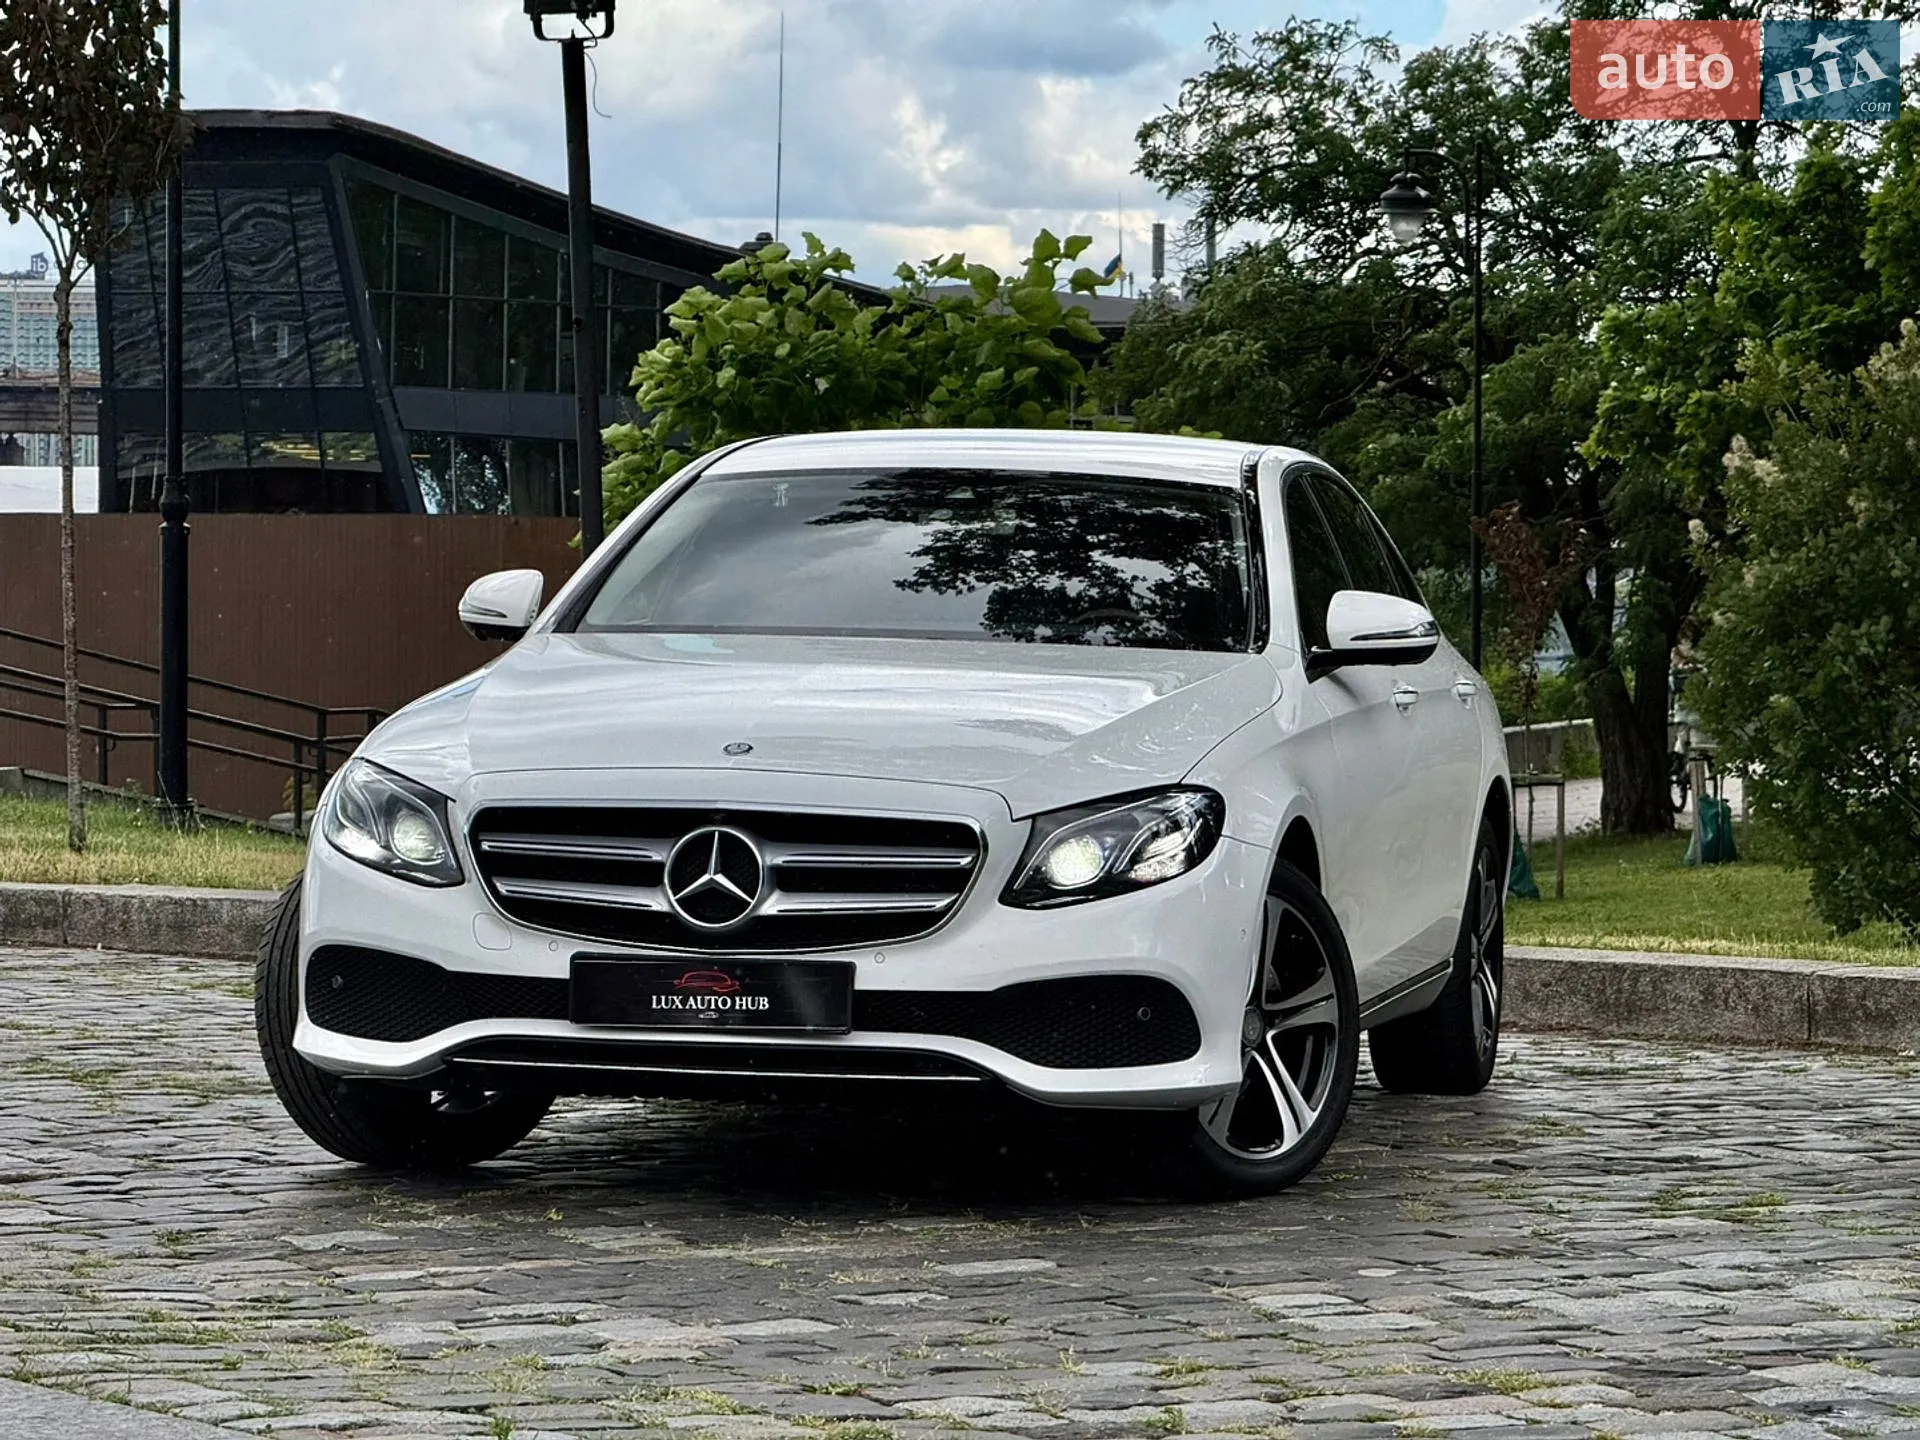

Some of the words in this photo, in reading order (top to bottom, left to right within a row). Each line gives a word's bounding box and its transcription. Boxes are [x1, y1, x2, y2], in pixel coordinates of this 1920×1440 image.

[651, 995, 683, 1009] LUX
[685, 995, 732, 1010] AUTO
[734, 996, 770, 1010] HUB
